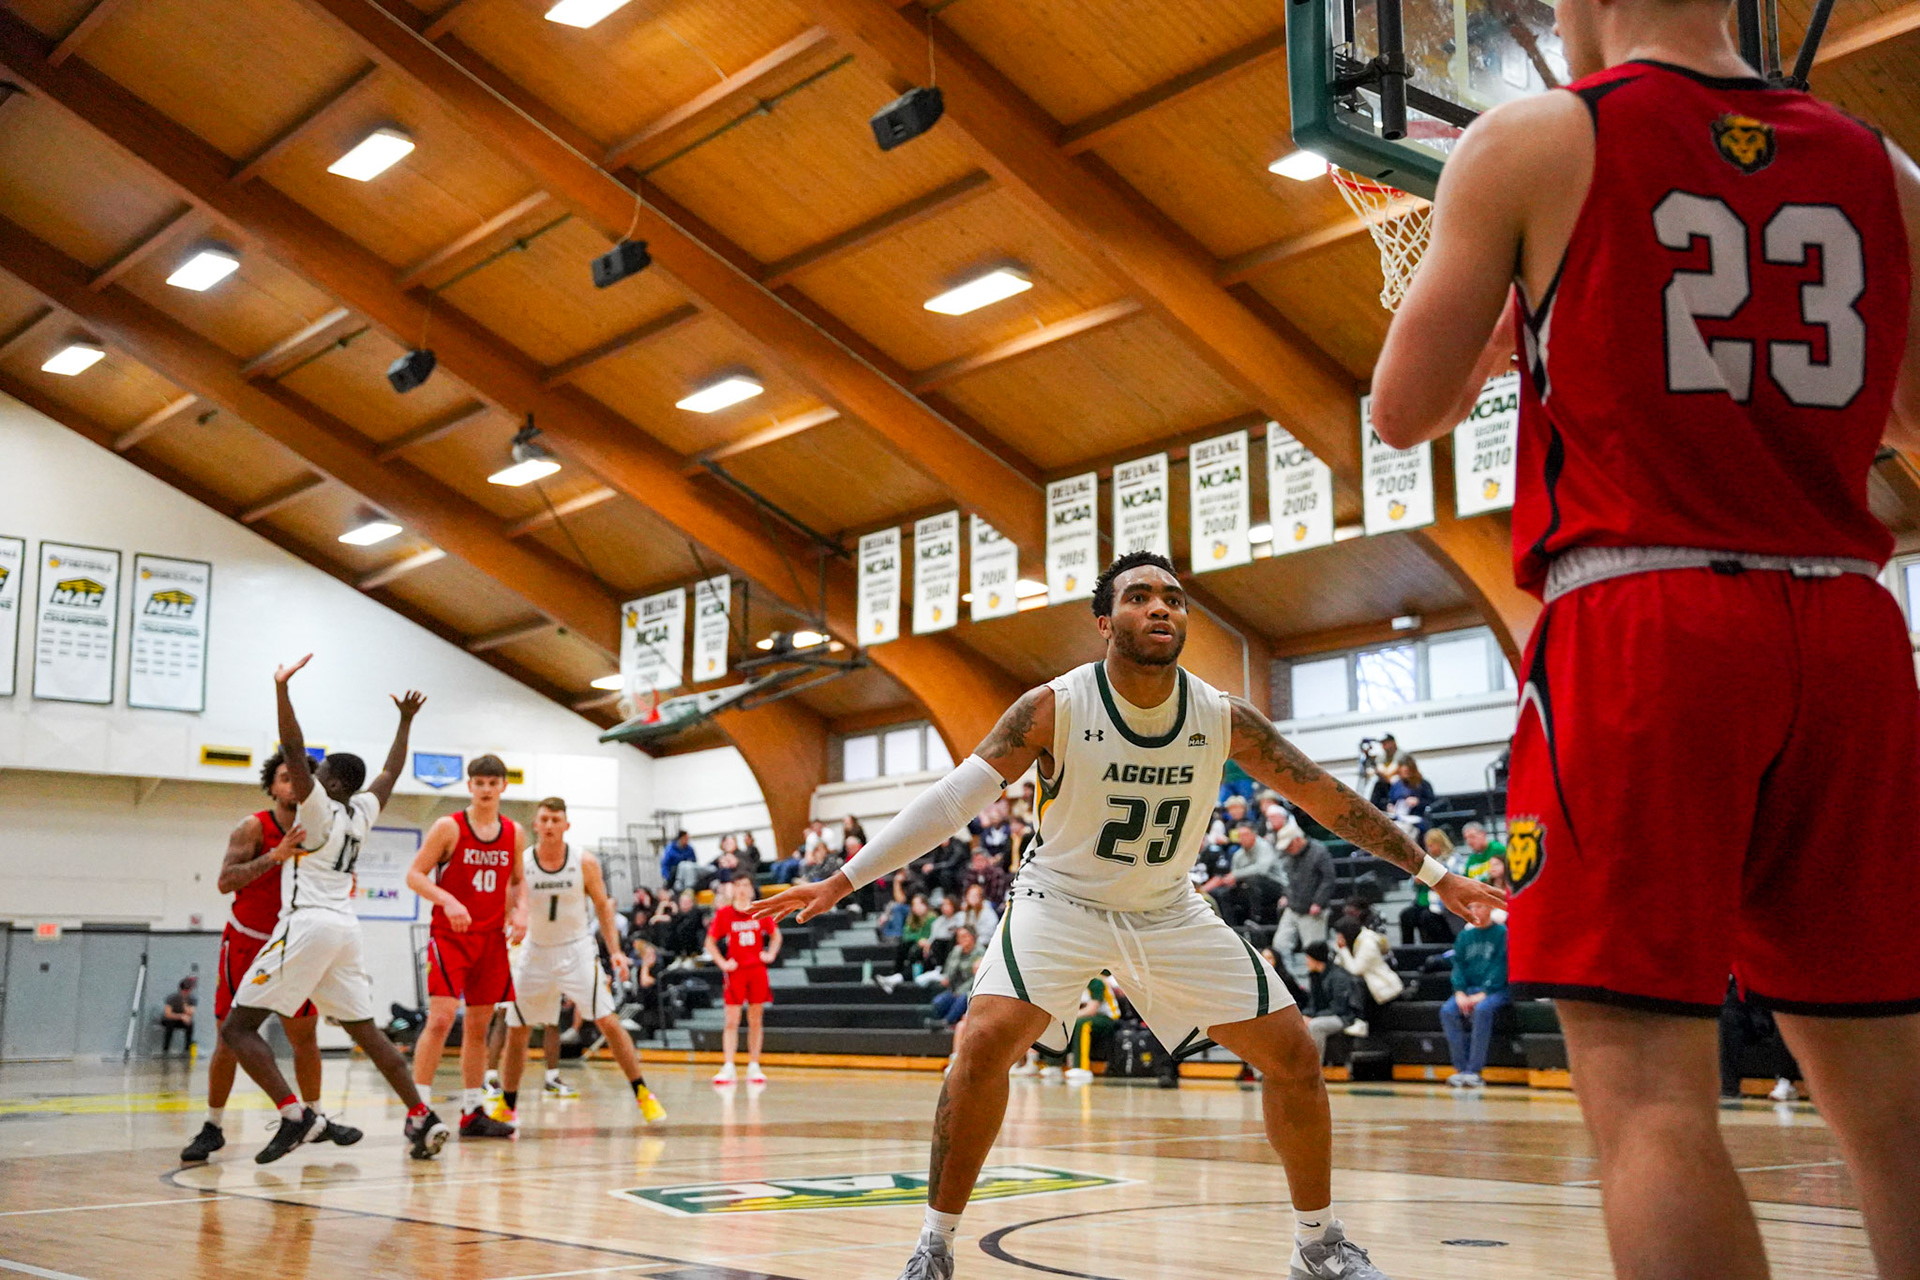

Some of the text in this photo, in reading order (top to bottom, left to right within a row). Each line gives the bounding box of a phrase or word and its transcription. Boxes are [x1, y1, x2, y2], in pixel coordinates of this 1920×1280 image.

[1651, 187, 1867, 409] 23
[1275, 447, 1315, 471] NCA
[1472, 446, 1512, 473] 2010
[1197, 466, 1242, 490] NCAA
[1376, 472, 1417, 496] 2009
[1121, 487, 1162, 509] NCAA
[1054, 503, 1092, 527] NCAA
[921, 540, 953, 560] NCAA
[865, 555, 895, 575] NCAA
[51, 588, 103, 608] MAC
[146, 599, 194, 619] MAC
[1102, 761, 1195, 786] AGGIES
[1093, 795, 1193, 868] 23
[464, 848, 510, 867] KING'S
[472, 869, 498, 893] 40
[549, 894, 559, 922] 1
